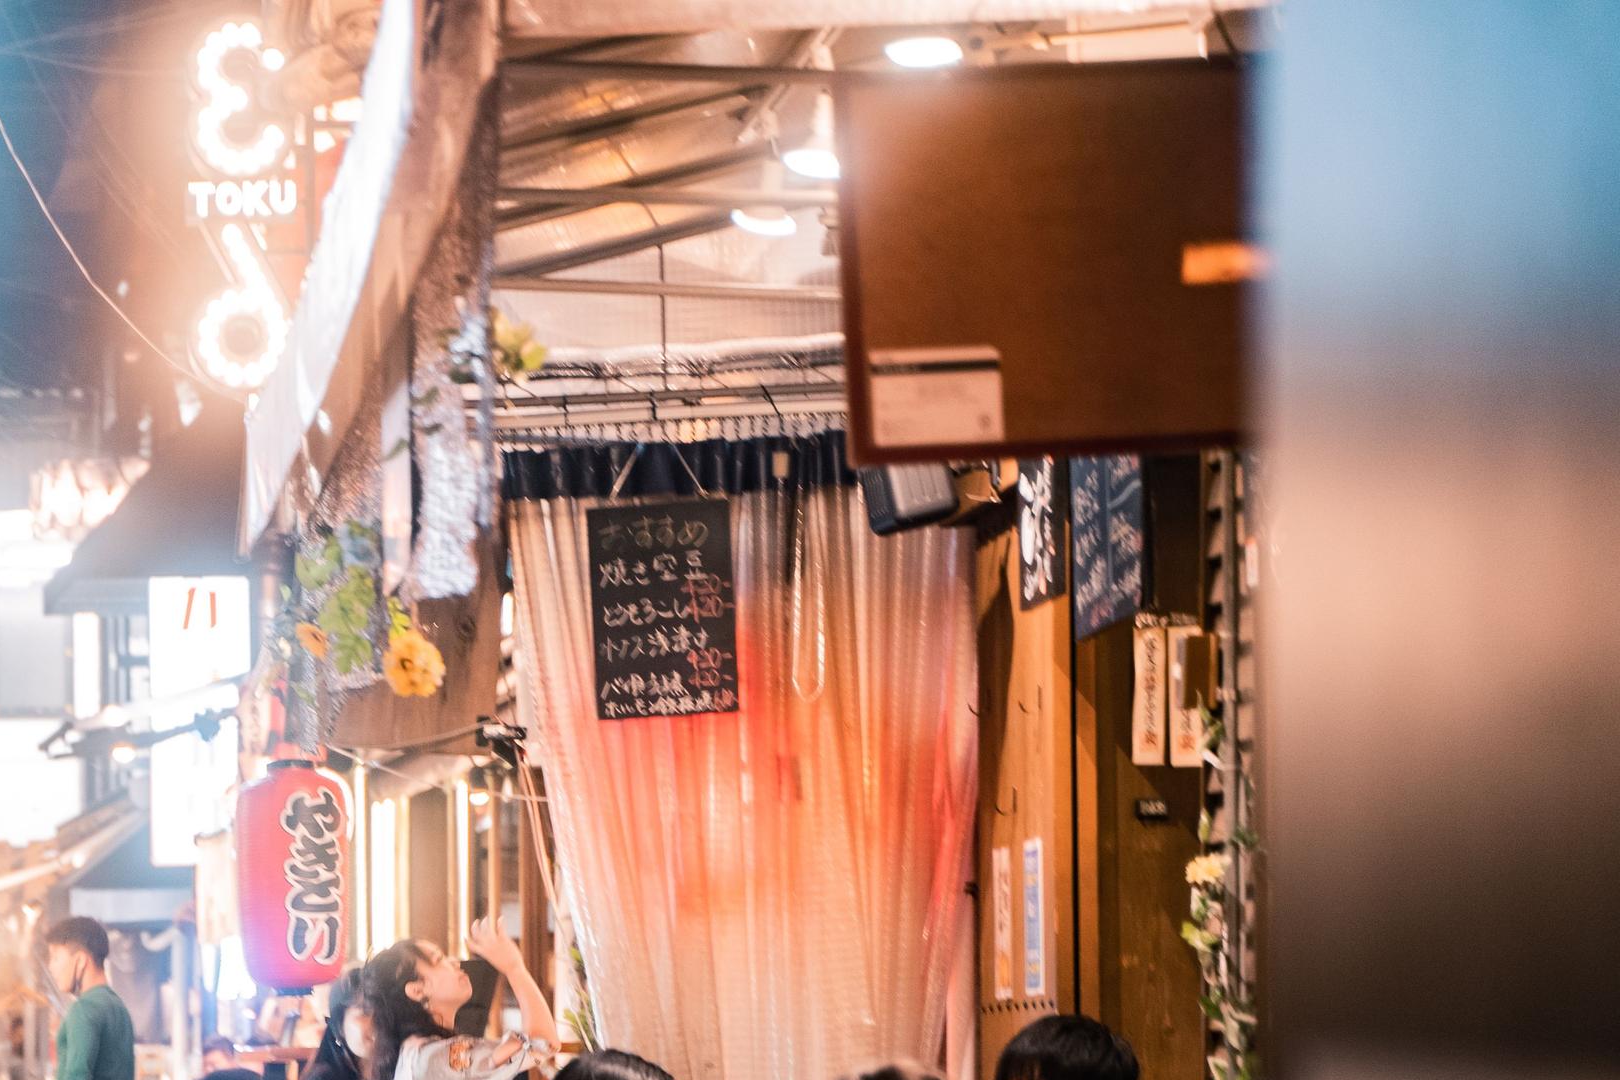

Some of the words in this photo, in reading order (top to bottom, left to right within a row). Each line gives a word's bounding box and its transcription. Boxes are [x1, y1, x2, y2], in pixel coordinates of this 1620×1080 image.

[188, 179, 298, 219] TOKU
[282, 788, 343, 962] やきとり
